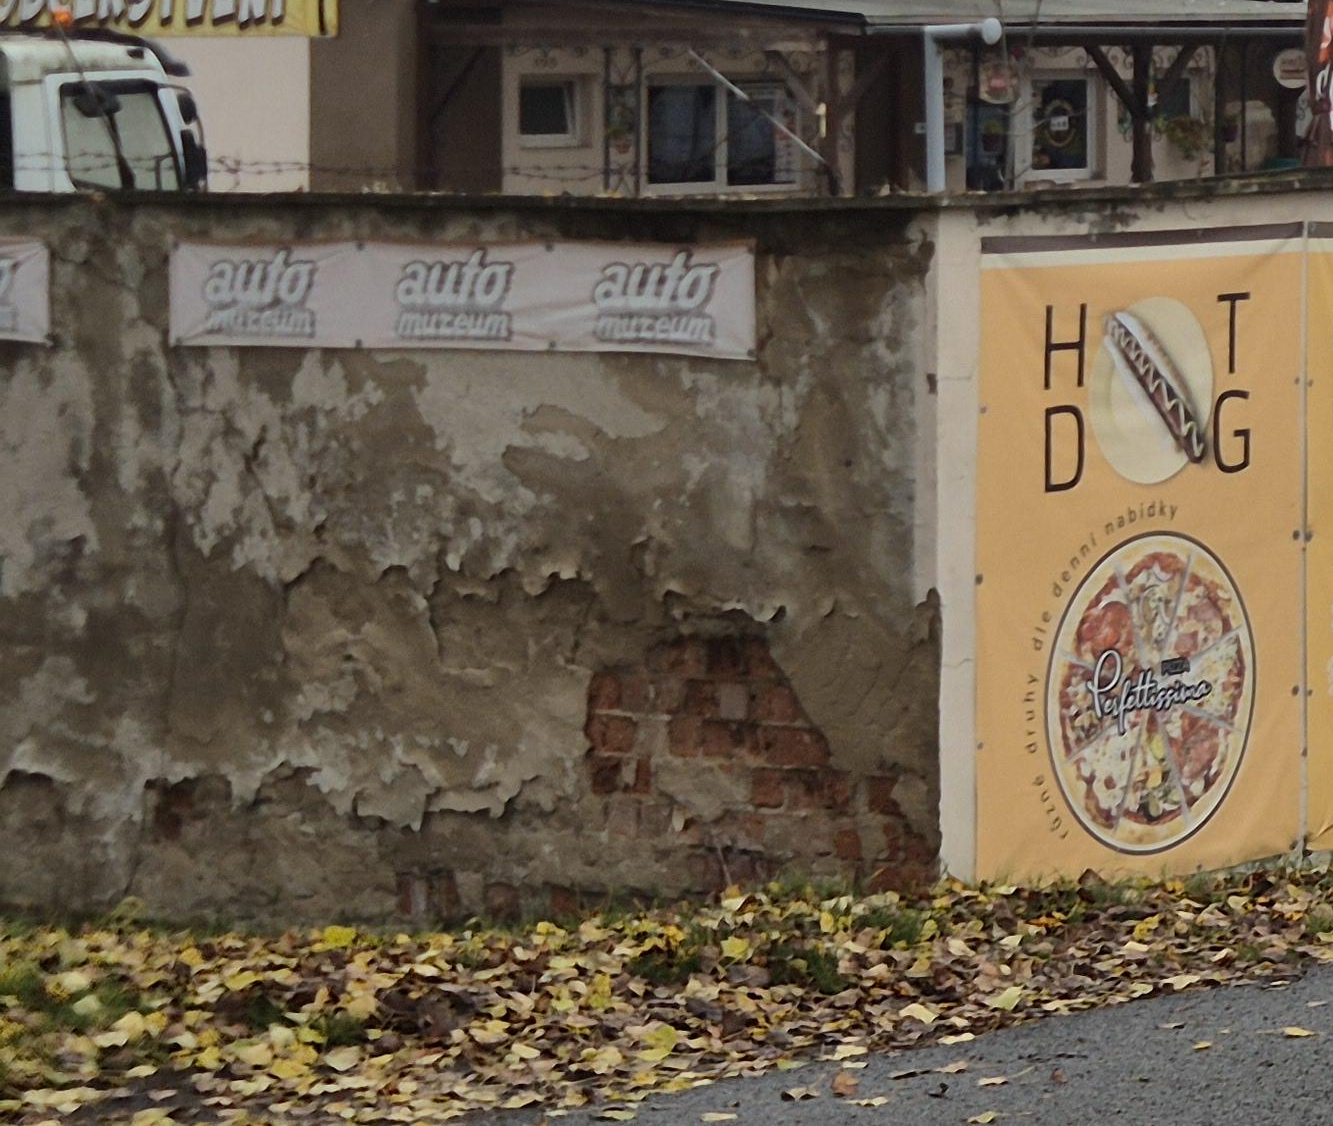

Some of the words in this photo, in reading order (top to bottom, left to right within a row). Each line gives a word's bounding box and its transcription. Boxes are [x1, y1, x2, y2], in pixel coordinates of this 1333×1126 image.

[206, 251, 317, 306] auto
[397, 250, 514, 306] auto
[594, 252, 715, 308] auto
[205, 304, 315, 340] muzeum
[398, 306, 512, 340] muzeum
[594, 308, 714, 344] muzeum
[1023, 673, 1041, 755] druhy
[1032, 610, 1054, 652] dle
